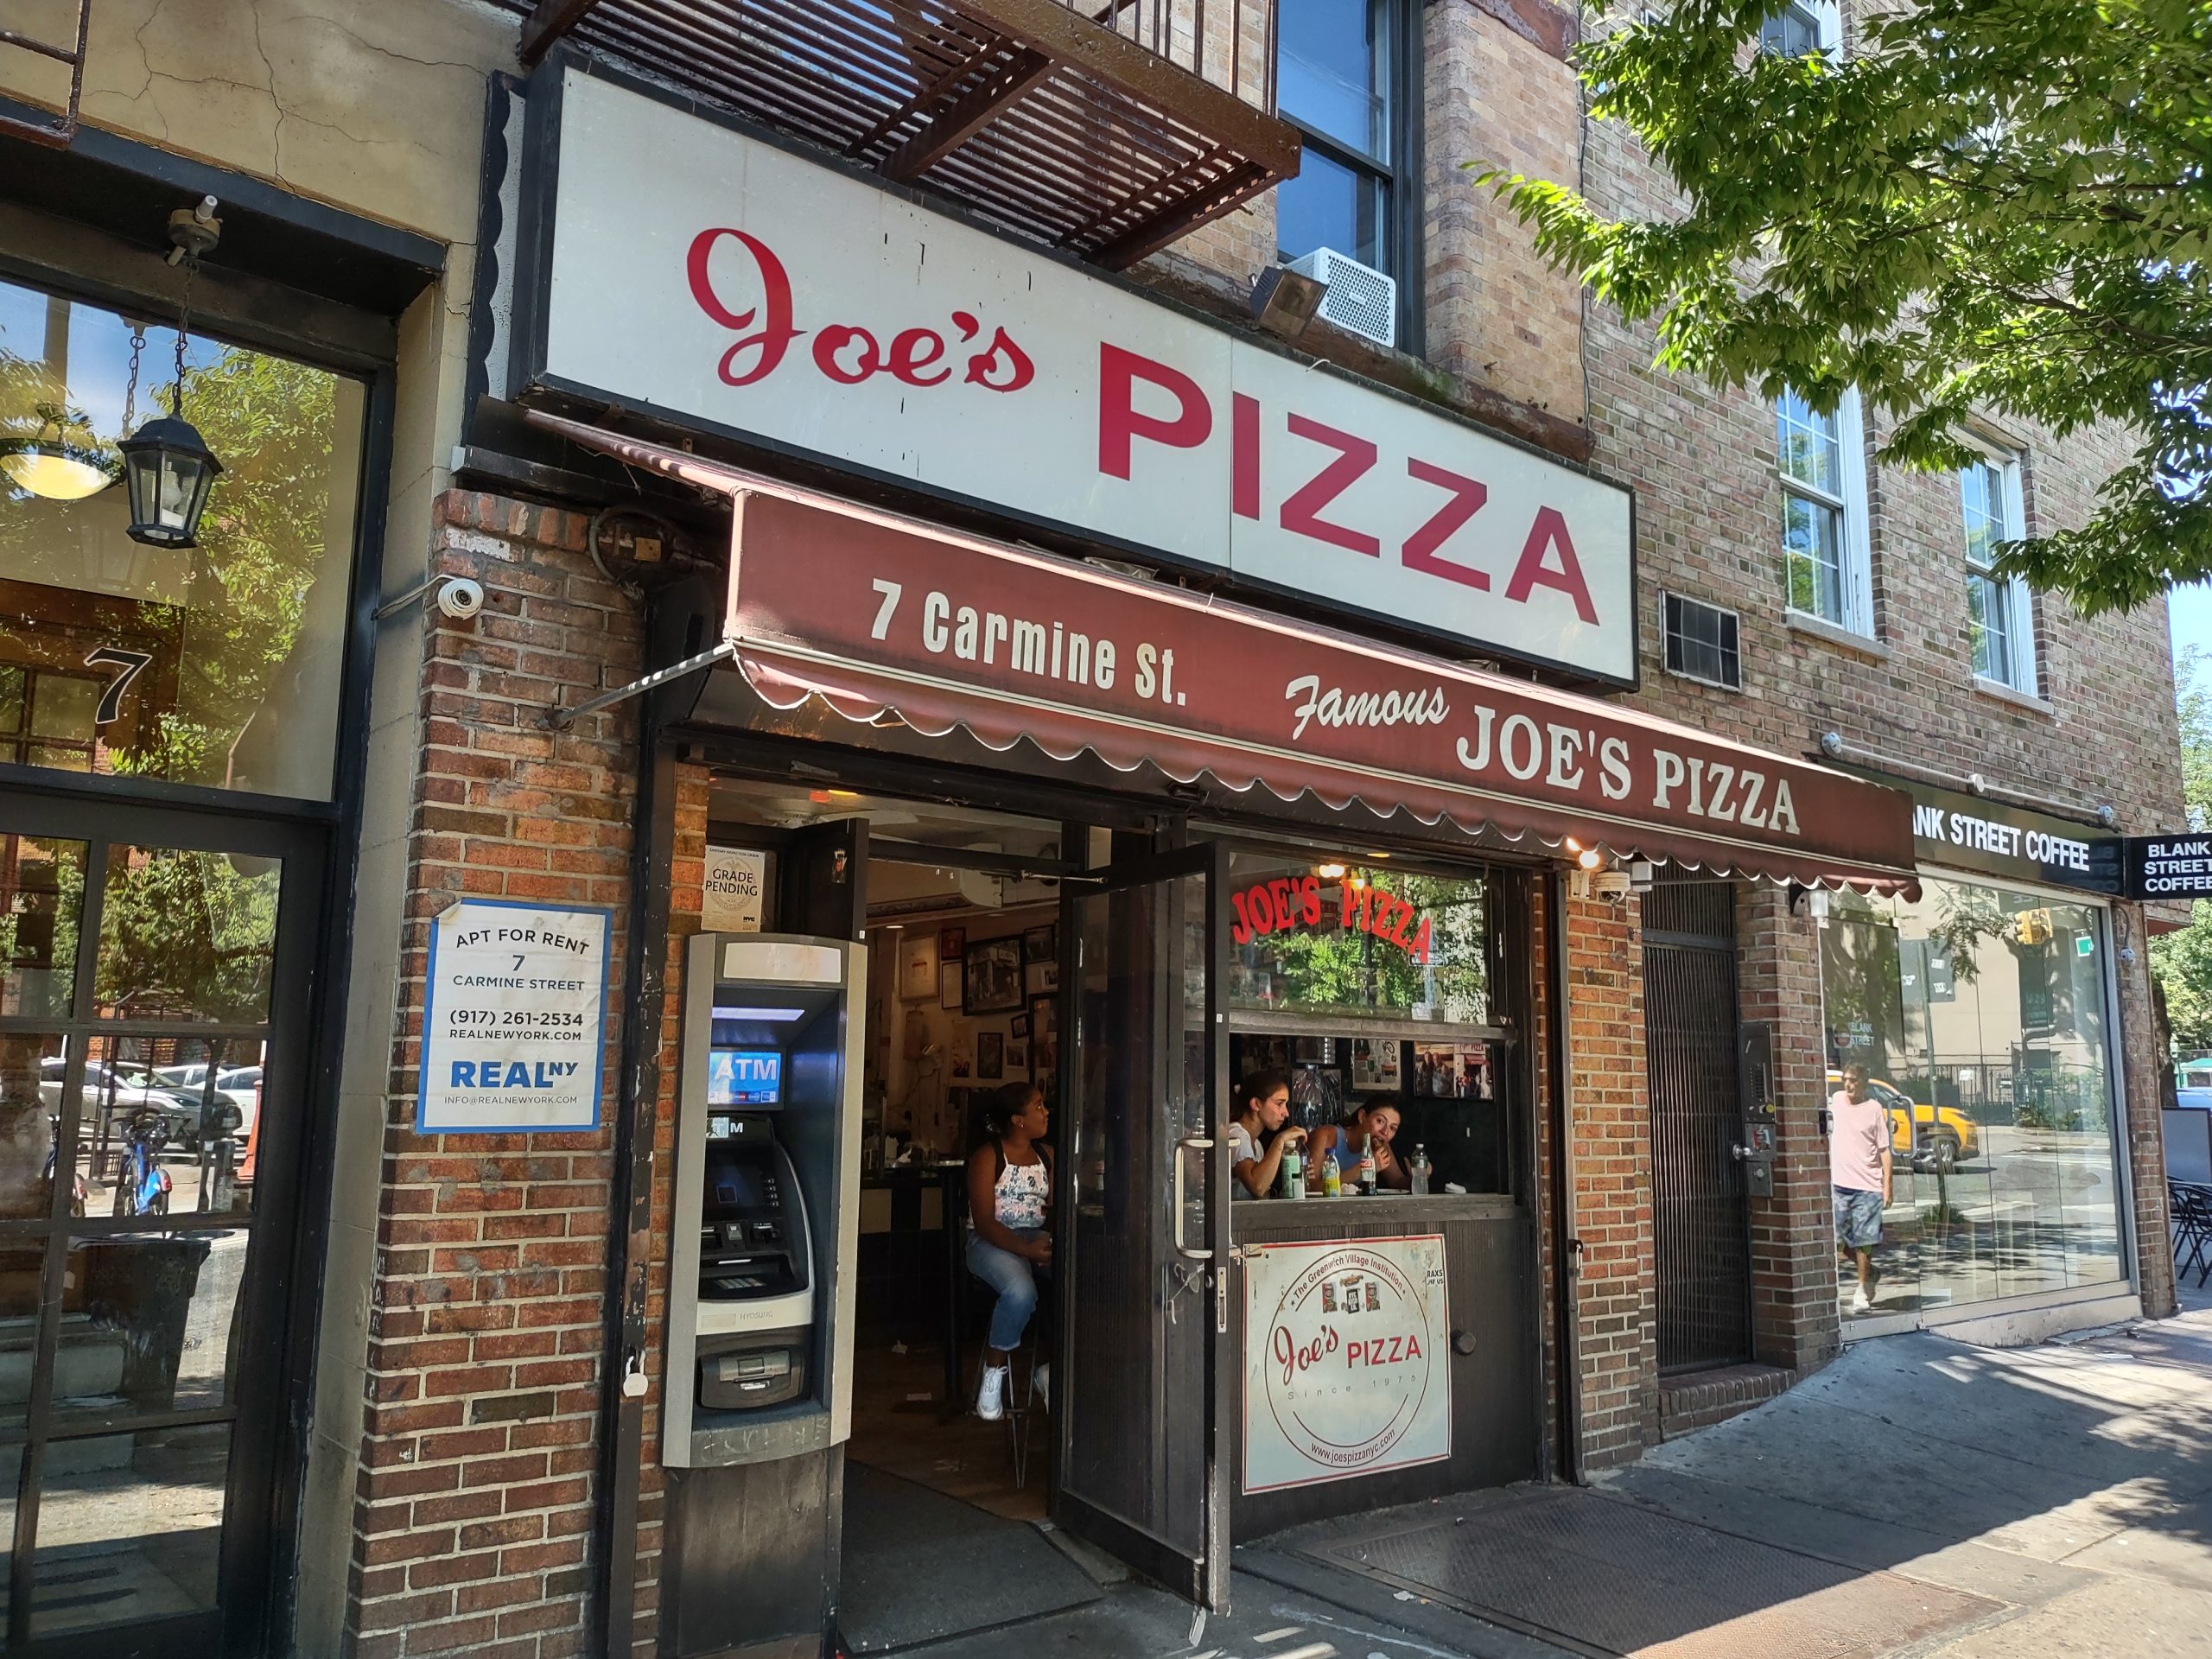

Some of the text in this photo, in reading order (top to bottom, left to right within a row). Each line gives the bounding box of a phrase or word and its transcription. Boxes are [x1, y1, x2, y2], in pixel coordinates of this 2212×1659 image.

[687, 227, 1600, 626] Joe's PIZZA
[871, 578, 1186, 706] 7 Carmine St.
[83, 646, 154, 725] 7
[1285, 675, 1801, 836] Famous JOE'S PIZZA
[1950, 812, 2021, 857] STREET
[2025, 830, 2089, 871] COFFEE
[2148, 842, 2212, 858] BLANK
[712, 868, 753, 883] GRADE
[2144, 859, 2212, 875] STREET
[705, 880, 758, 896] PENDING
[1231, 875, 1431, 964] JOE'S PIZZA
[456, 929, 589, 955] APT FOR RENT
[512, 955, 525, 972] 7
[453, 975, 585, 991] CARMINE STREET
[450, 1009, 583, 1027] (917) 261-2534
[449, 1029, 582, 1040] REALNEWYORK.COM
[715, 1058, 777, 1080] ATM
[444, 1096, 577, 1104] INFO@REALNEWYORK.COM
[1293, 1254, 1402, 1299] The Greenwich Village Institution
[1274, 1325, 1421, 1386] Joe's PIZZA
[1287, 1375, 1415, 1400] Since 1975
[1310, 1429, 1395, 1465] www.joespizzanyc.com
